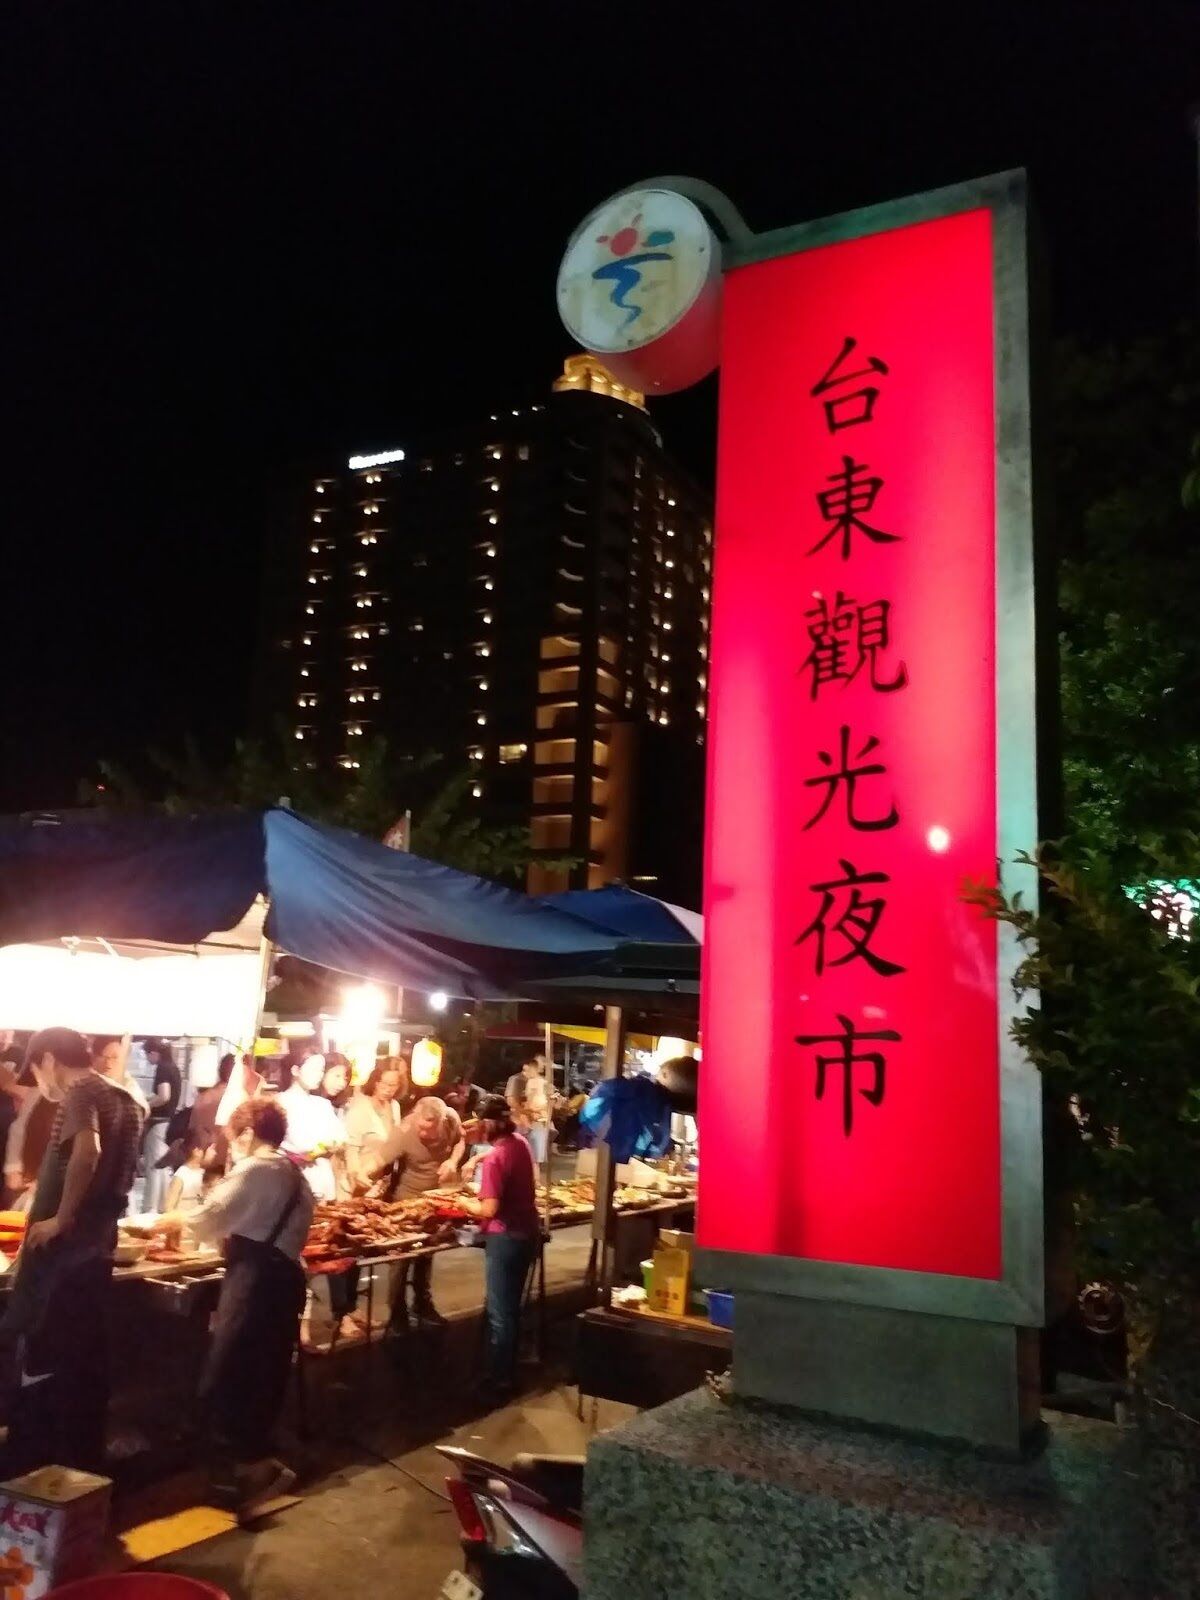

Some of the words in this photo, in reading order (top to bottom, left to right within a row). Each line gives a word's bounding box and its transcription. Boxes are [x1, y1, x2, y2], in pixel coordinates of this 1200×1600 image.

[796, 336, 907, 1137] 台東觀光夜市
